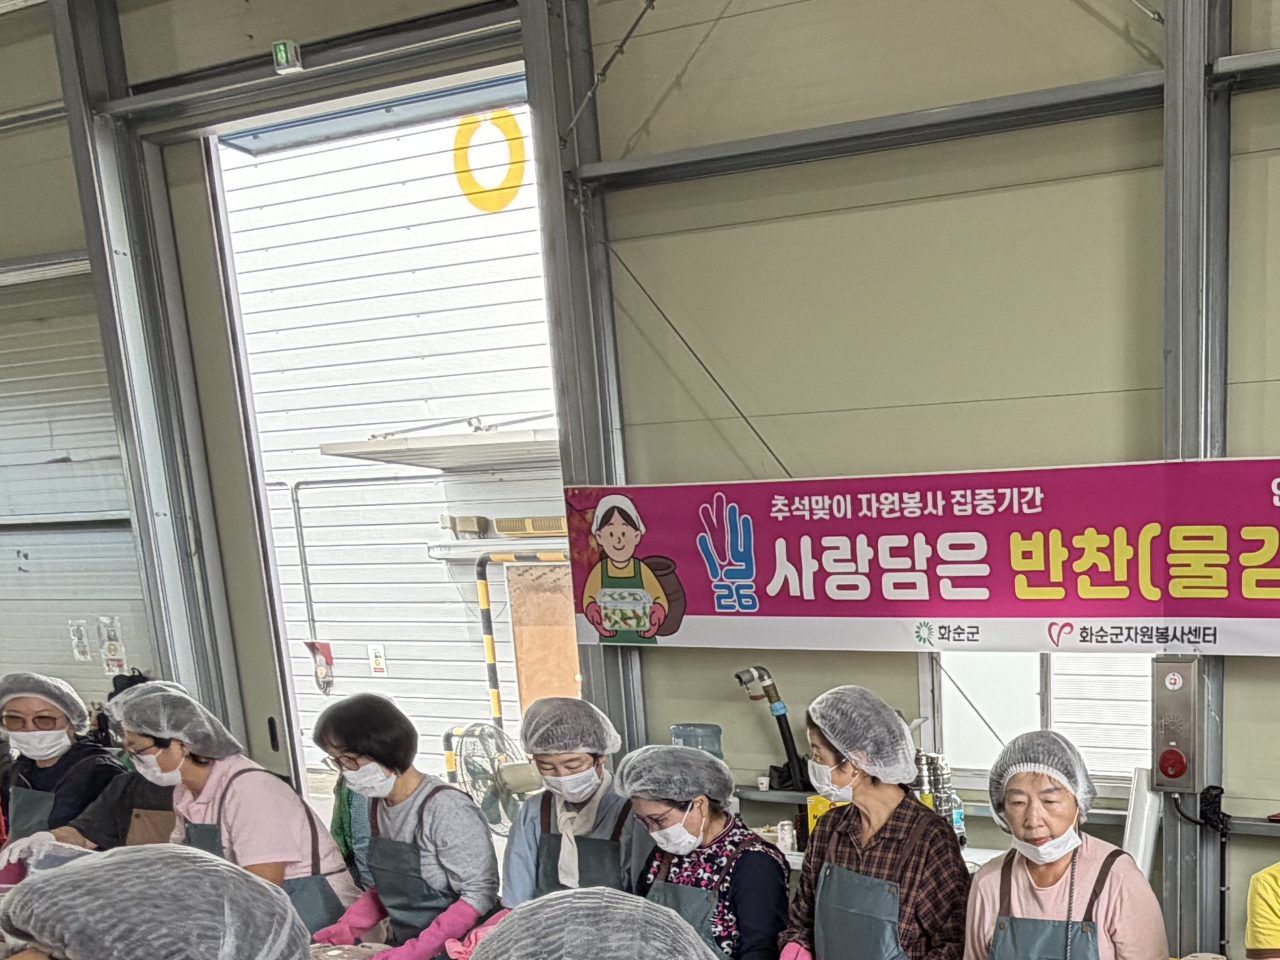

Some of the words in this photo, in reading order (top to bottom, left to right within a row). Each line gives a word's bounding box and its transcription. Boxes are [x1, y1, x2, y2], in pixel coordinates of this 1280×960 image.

[770, 494, 852, 521] 추석맞이
[857, 490, 946, 519] 자원봉사
[950, 486, 1044, 516] 집중기간
[765, 531, 991, 601] 사랑담은
[937, 625, 980, 643] 화순군
[1079, 625, 1217, 645] 화순군자원봉사센터
